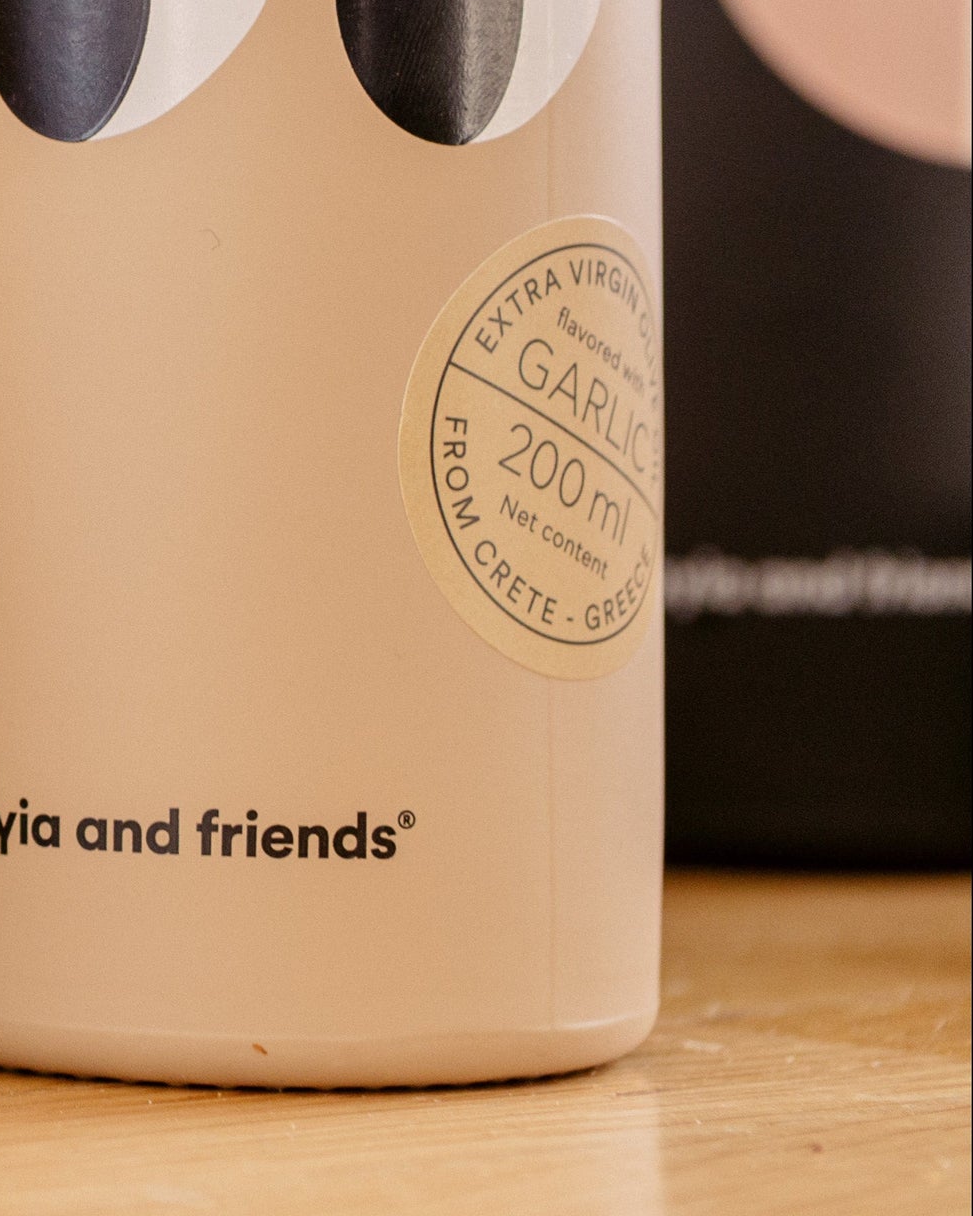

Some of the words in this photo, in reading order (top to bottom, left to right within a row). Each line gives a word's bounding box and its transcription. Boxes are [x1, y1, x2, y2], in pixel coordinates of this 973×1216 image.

[474, 267, 562, 354] EXTRA
[569, 259, 640, 314] VIRGIN
[556, 306, 622, 371] flavored
[518, 338, 649, 473] GARLIC
[442, 415, 480, 531] FROM
[474, 540, 558, 626] CRETE
[585, 543, 652, 631] GREECE
[498, 423, 586, 508] 200
[588, 486, 632, 546] ml
[499, 494, 539, 534] Net
[542, 521, 609, 581] content
[75, 808, 180, 855] and
